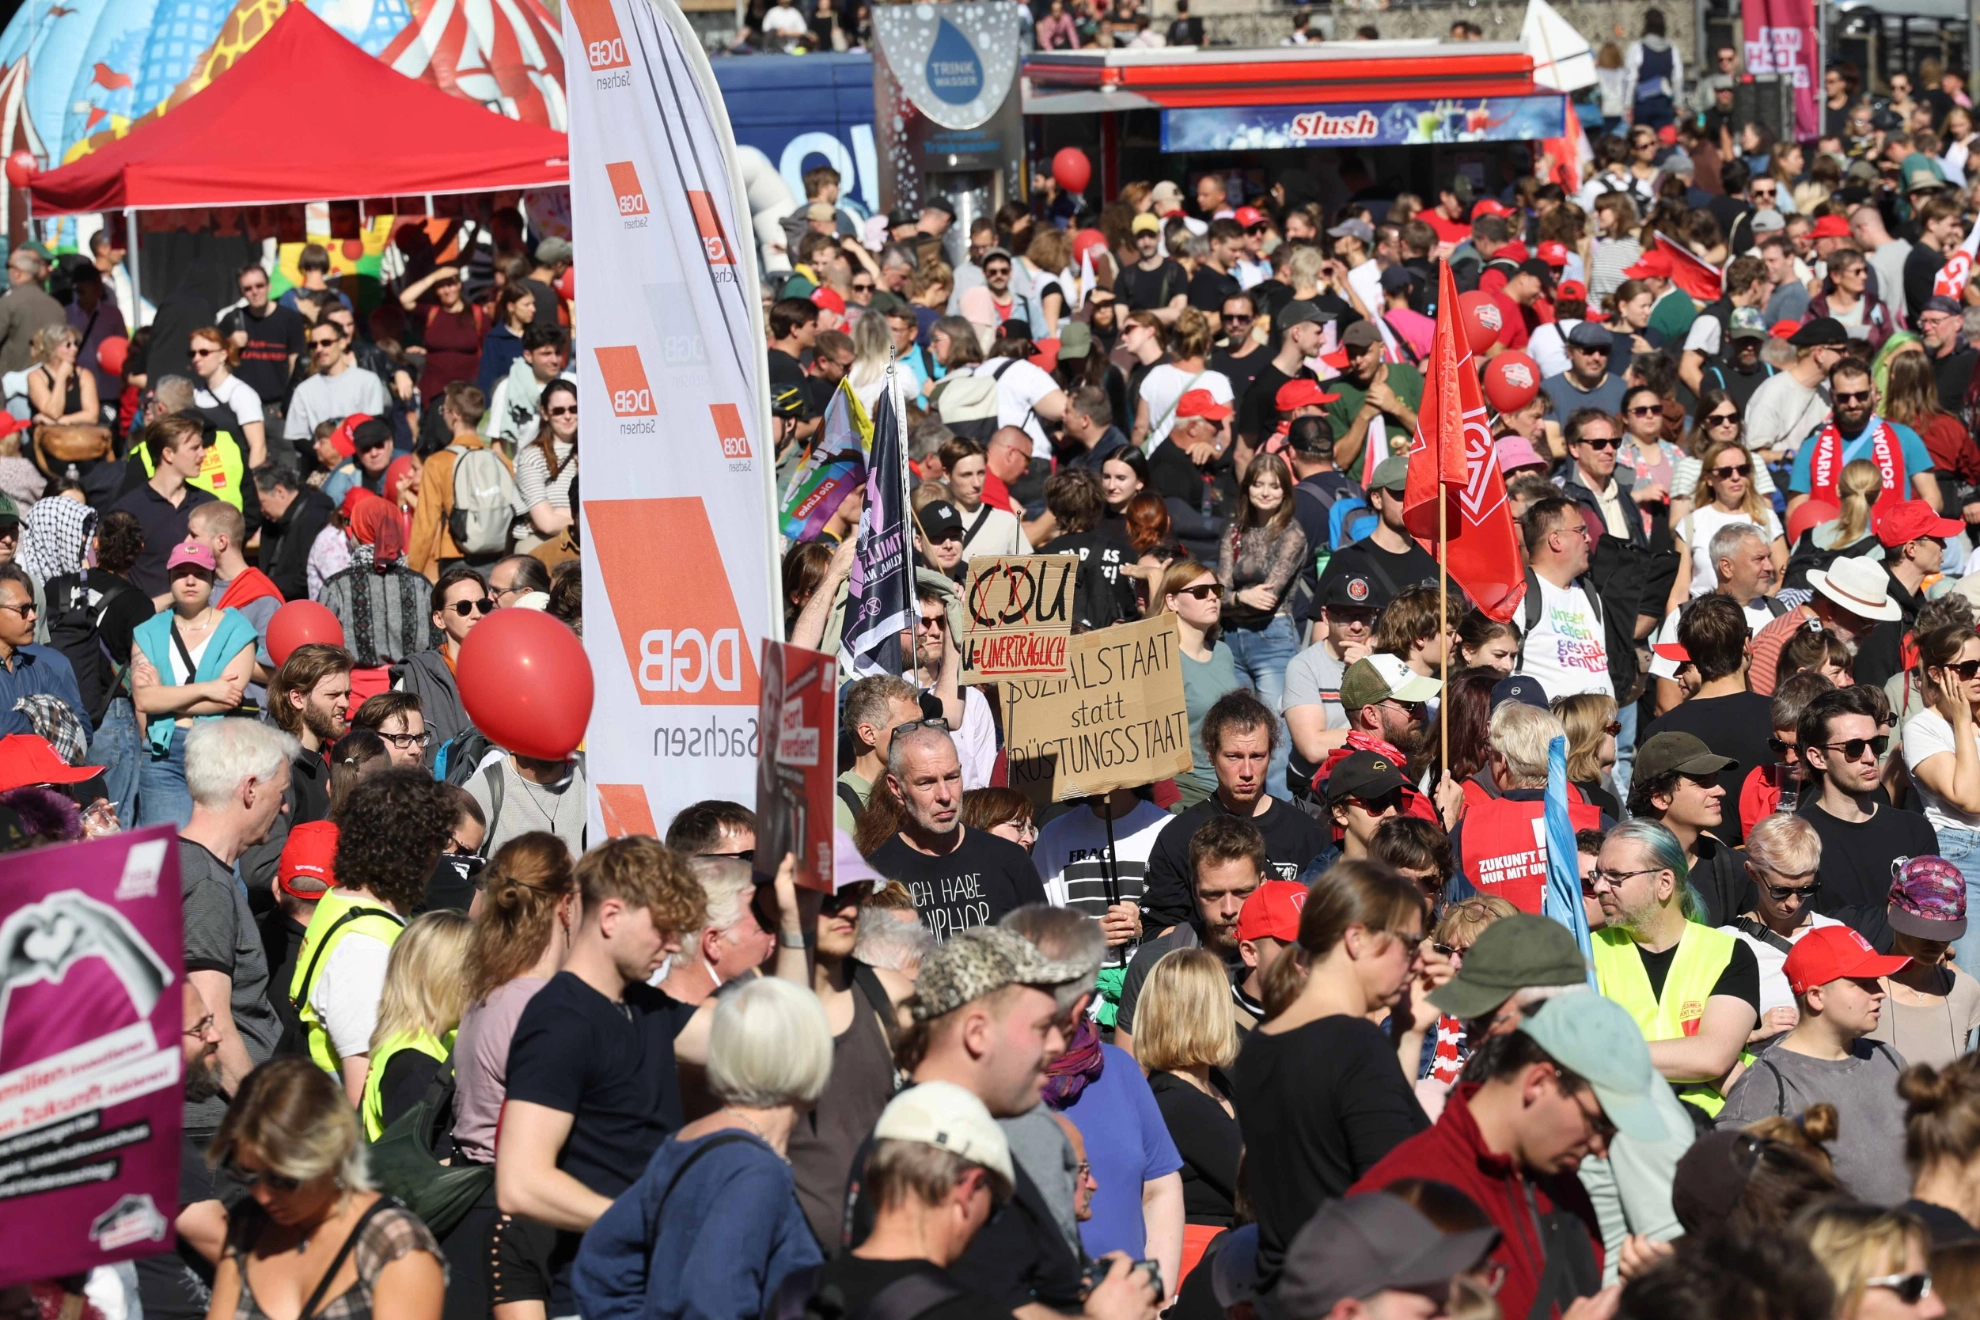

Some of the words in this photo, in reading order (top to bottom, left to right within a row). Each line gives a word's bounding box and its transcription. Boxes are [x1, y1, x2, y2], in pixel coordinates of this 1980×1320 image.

[932, 61, 975, 75] TRINK
[934, 77, 977, 87] WASSER
[1292, 112, 1377, 137] Slush
[1817, 436, 1833, 487] WARM
[969, 560, 1071, 627] CDU
[1551, 606, 1585, 625] Unser
[1551, 622, 1593, 641] Leben
[1071, 691, 1127, 728] statt
[1011, 710, 1186, 785] RÜSTUNGSSTAAT
[1478, 850, 1536, 873] ZUKUNFT
[1480, 870, 1505, 885] NUR
[1506, 866, 1528, 880] MIT
[1530, 862, 1547, 876] UN
[909, 881, 935, 907] ICH
[940, 873, 987, 903] HABE
